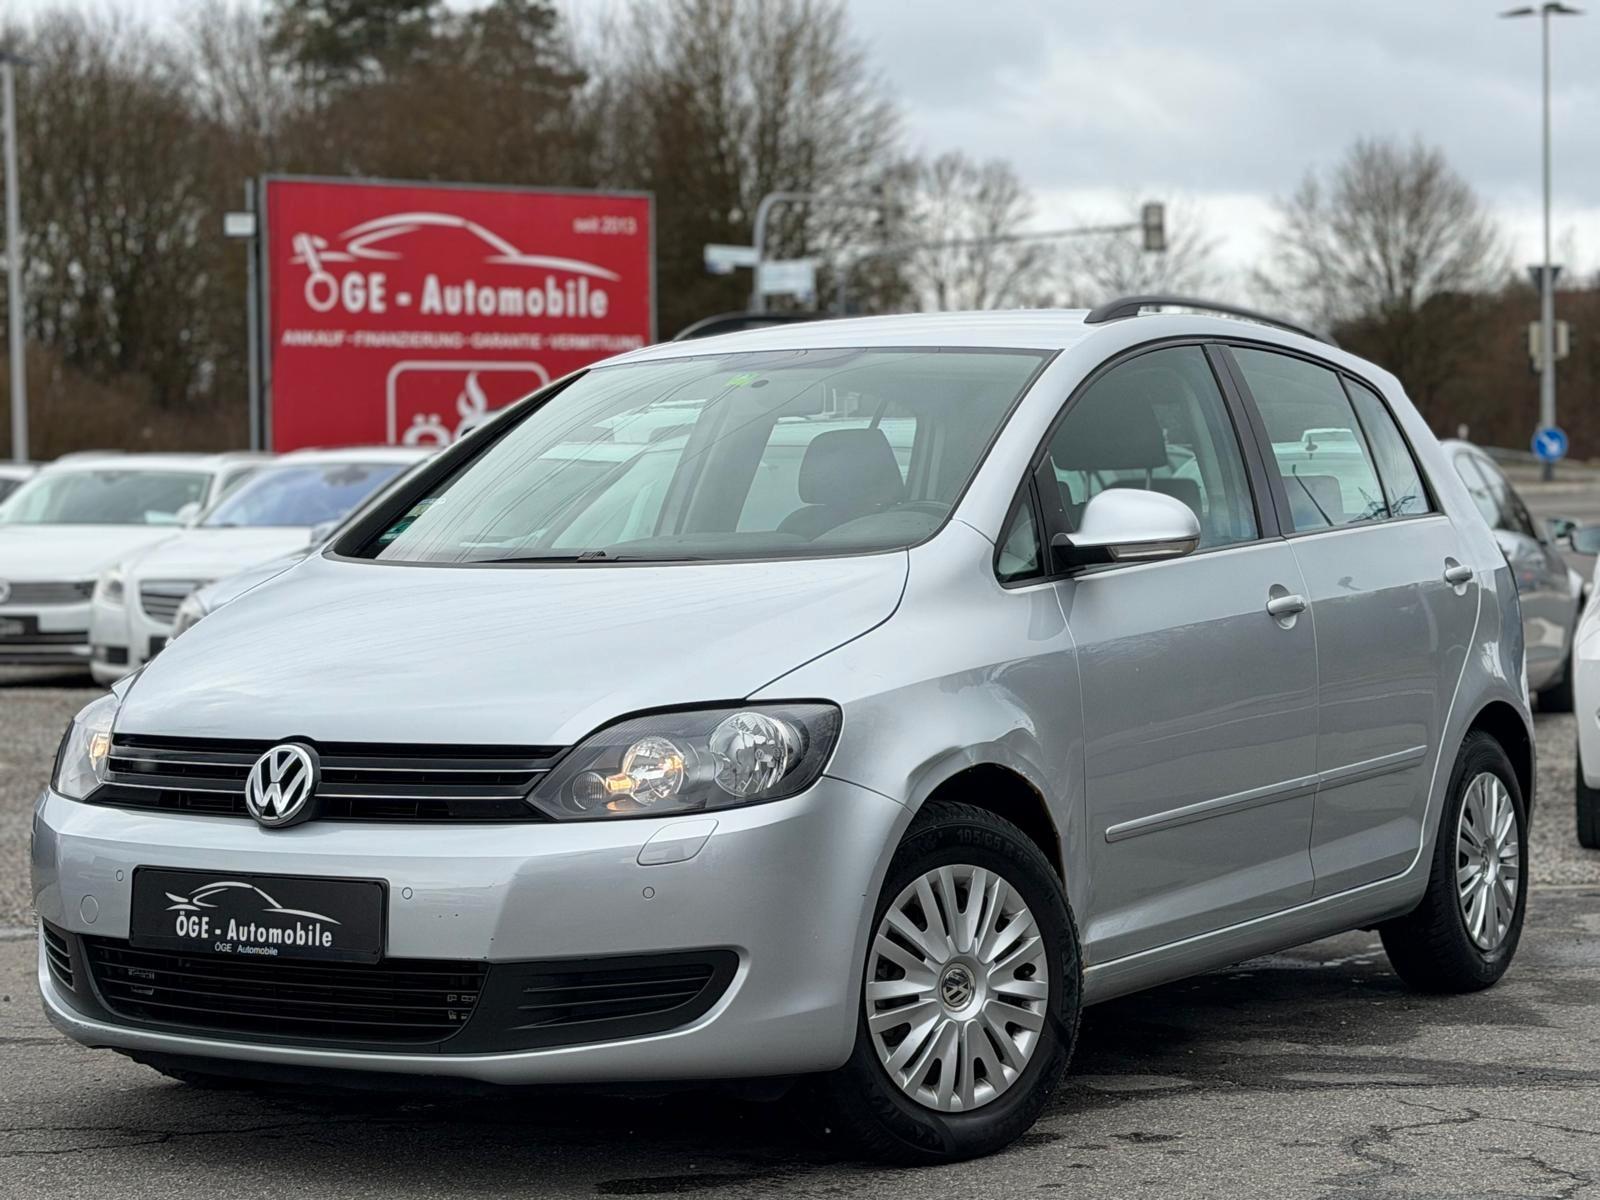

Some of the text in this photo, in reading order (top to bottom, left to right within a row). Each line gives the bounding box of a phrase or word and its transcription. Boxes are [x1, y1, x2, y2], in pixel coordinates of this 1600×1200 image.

[419, 273, 609, 320] Automobile
[175, 911, 210, 938] ÖGE
[226, 918, 333, 947] Automobile
[214, 941, 279, 956] ÖGE Automobile
